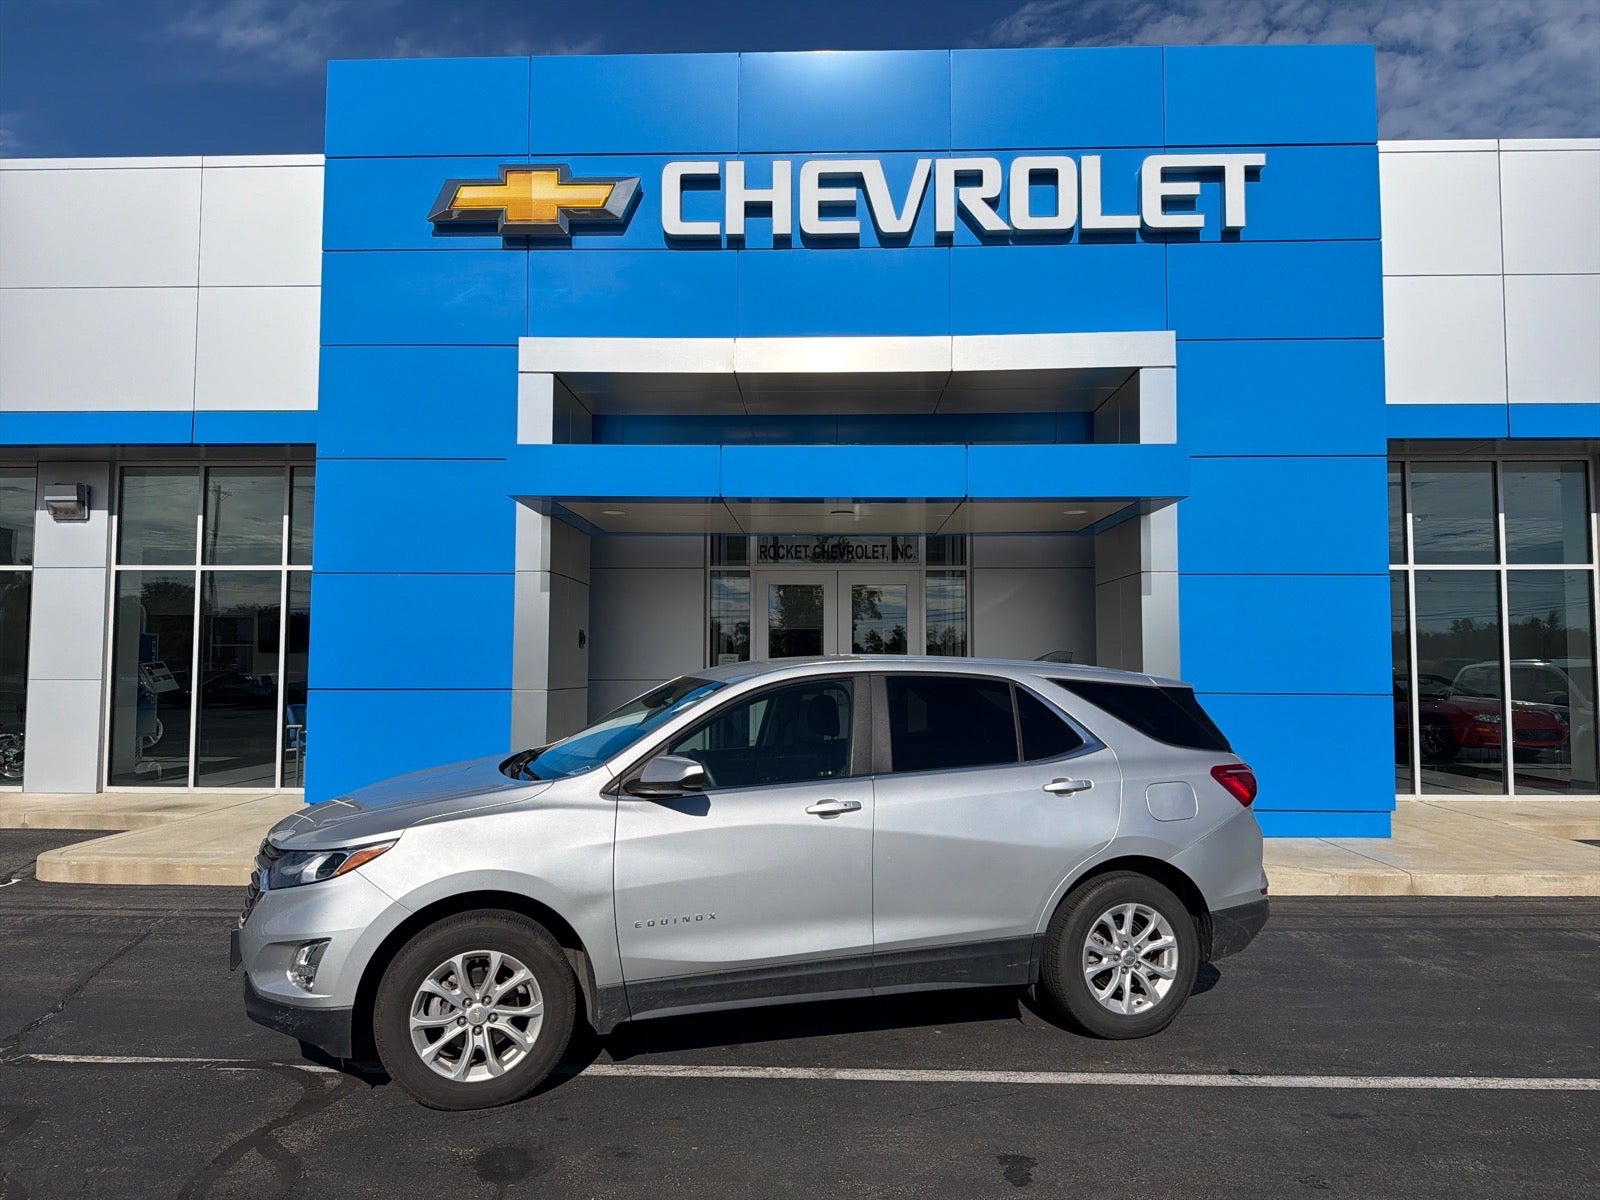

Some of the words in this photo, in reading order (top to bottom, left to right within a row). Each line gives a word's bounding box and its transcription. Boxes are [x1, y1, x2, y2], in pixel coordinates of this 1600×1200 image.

[661, 152, 1266, 241] CHEVROLET
[759, 544, 810, 560] ROCKET
[812, 544, 889, 561] CHEVROLET,
[892, 544, 917, 560] INC.
[634, 912, 717, 929] EQUINOX
